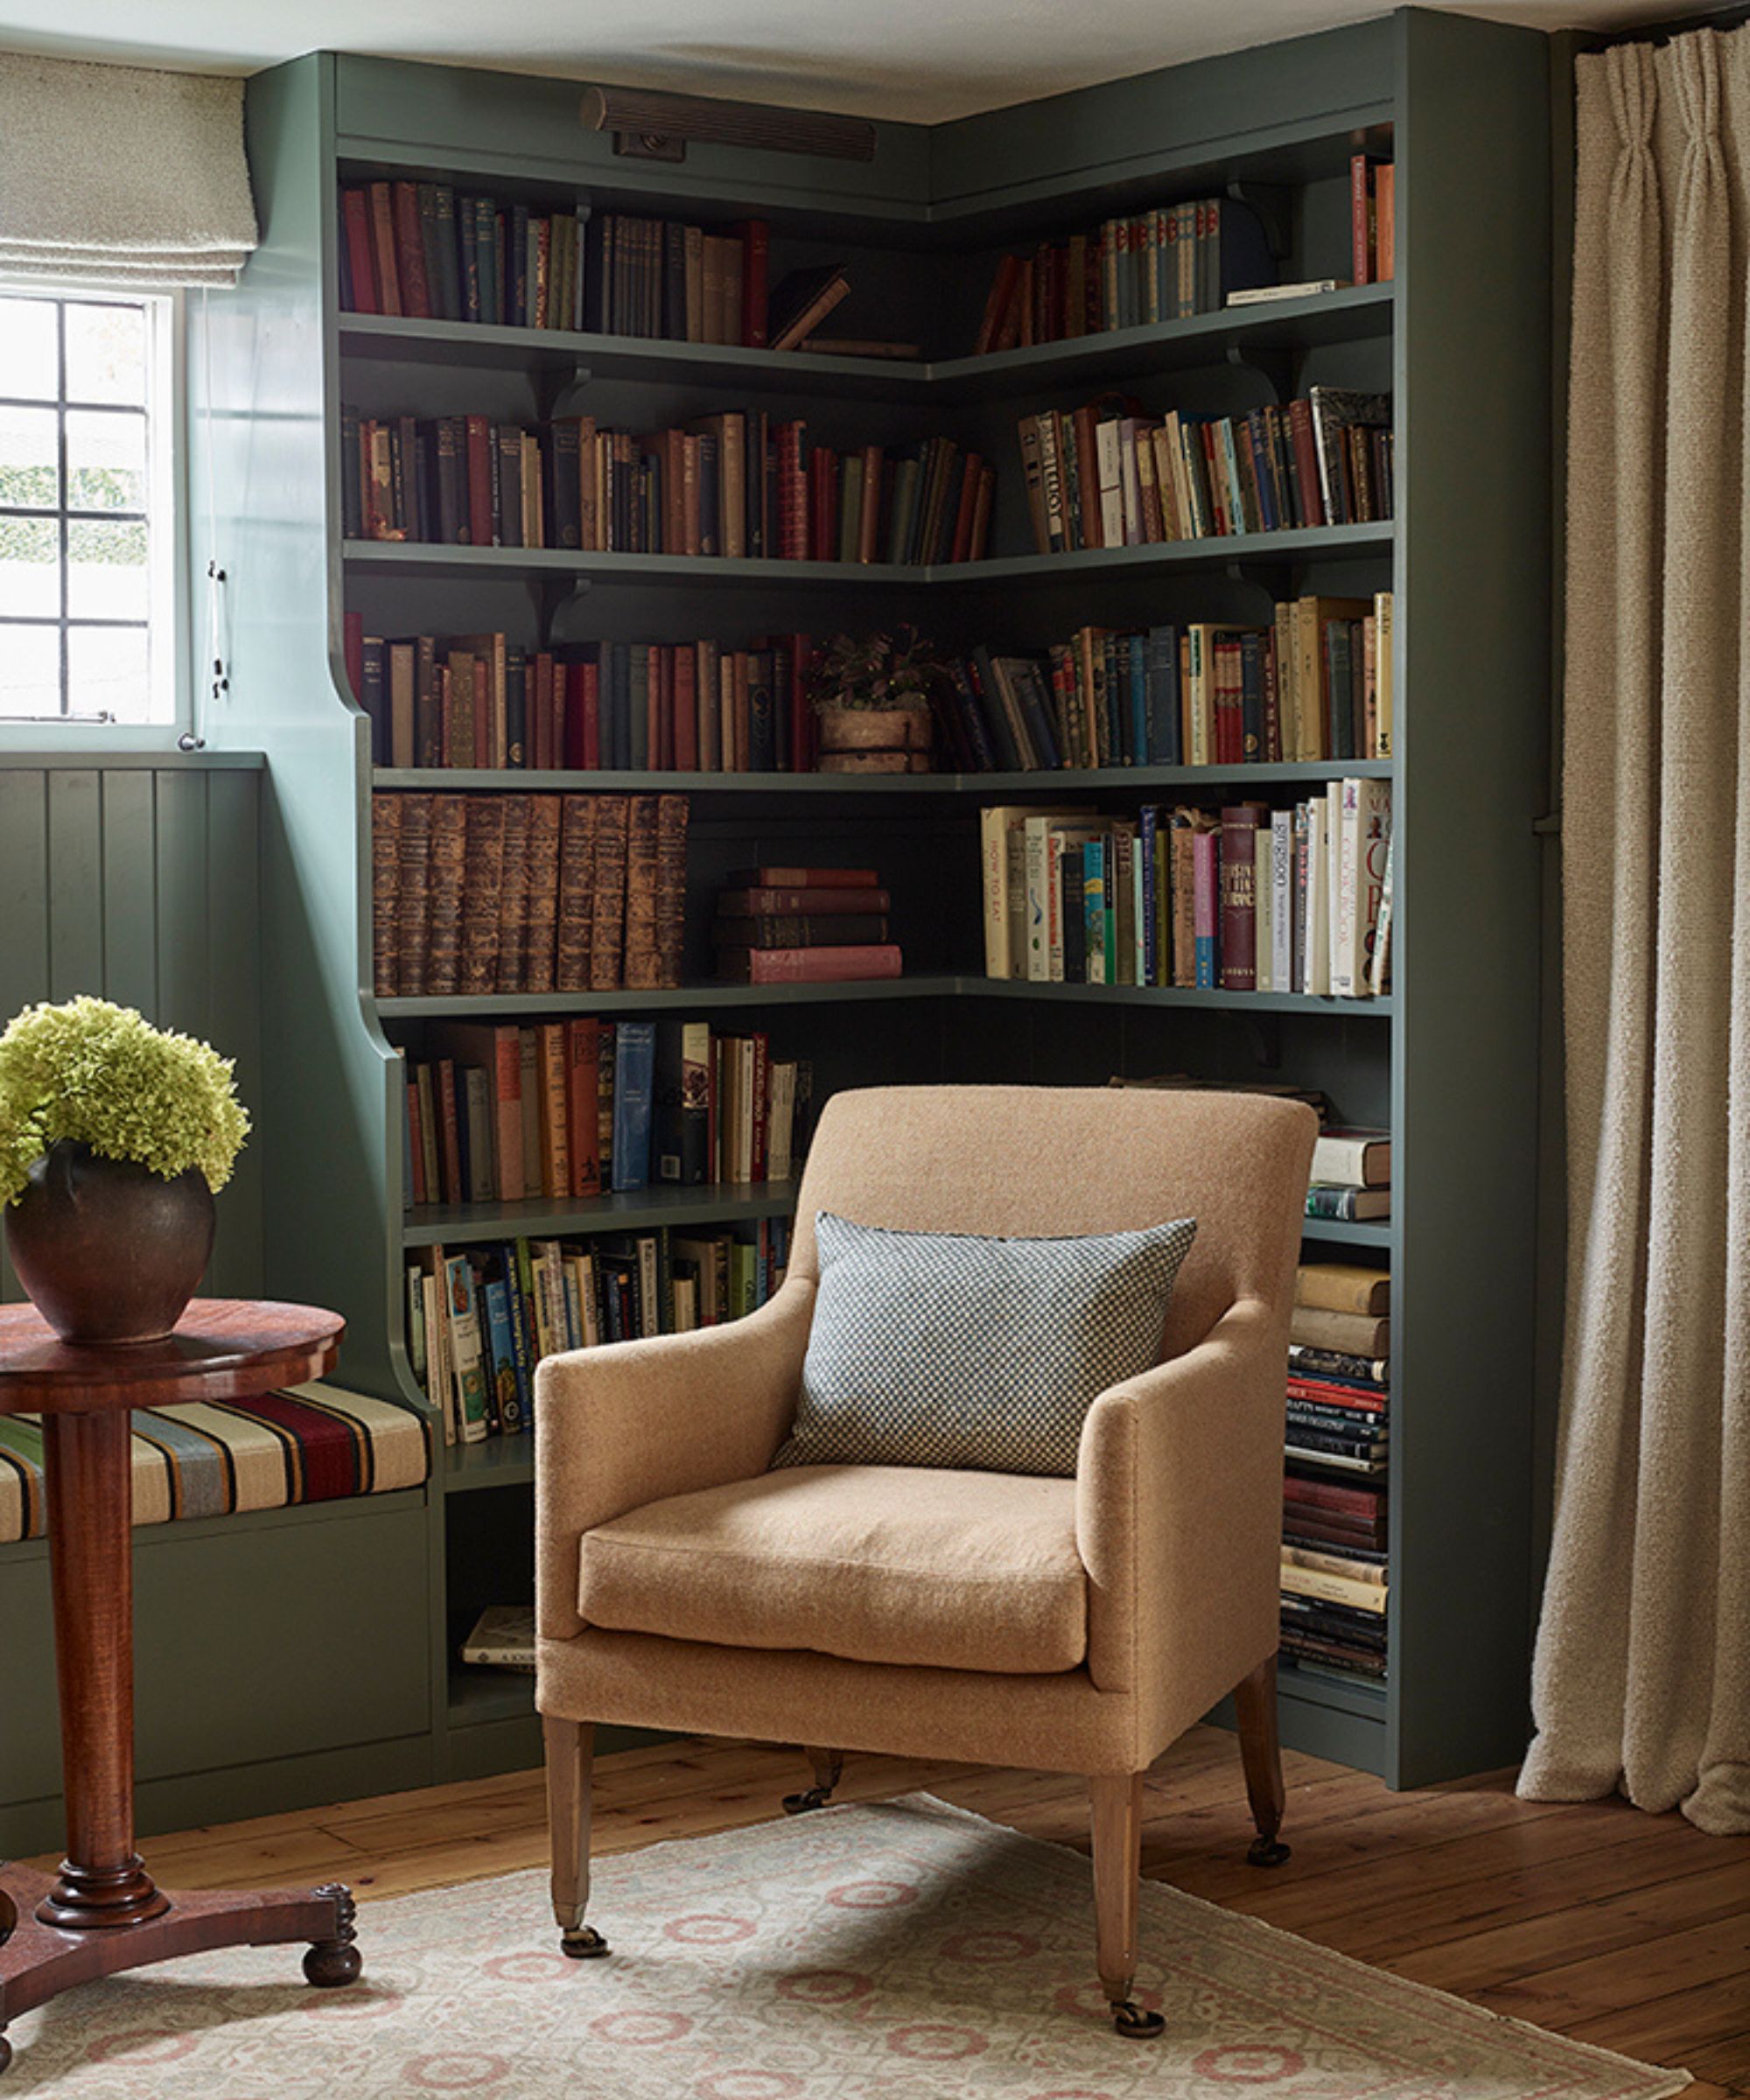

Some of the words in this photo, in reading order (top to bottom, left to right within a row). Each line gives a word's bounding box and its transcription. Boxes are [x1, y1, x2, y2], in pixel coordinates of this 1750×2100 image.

[990, 840, 999, 873] HOW
[991, 878, 1000, 894] TO
[992, 900, 1001, 923] EAT
